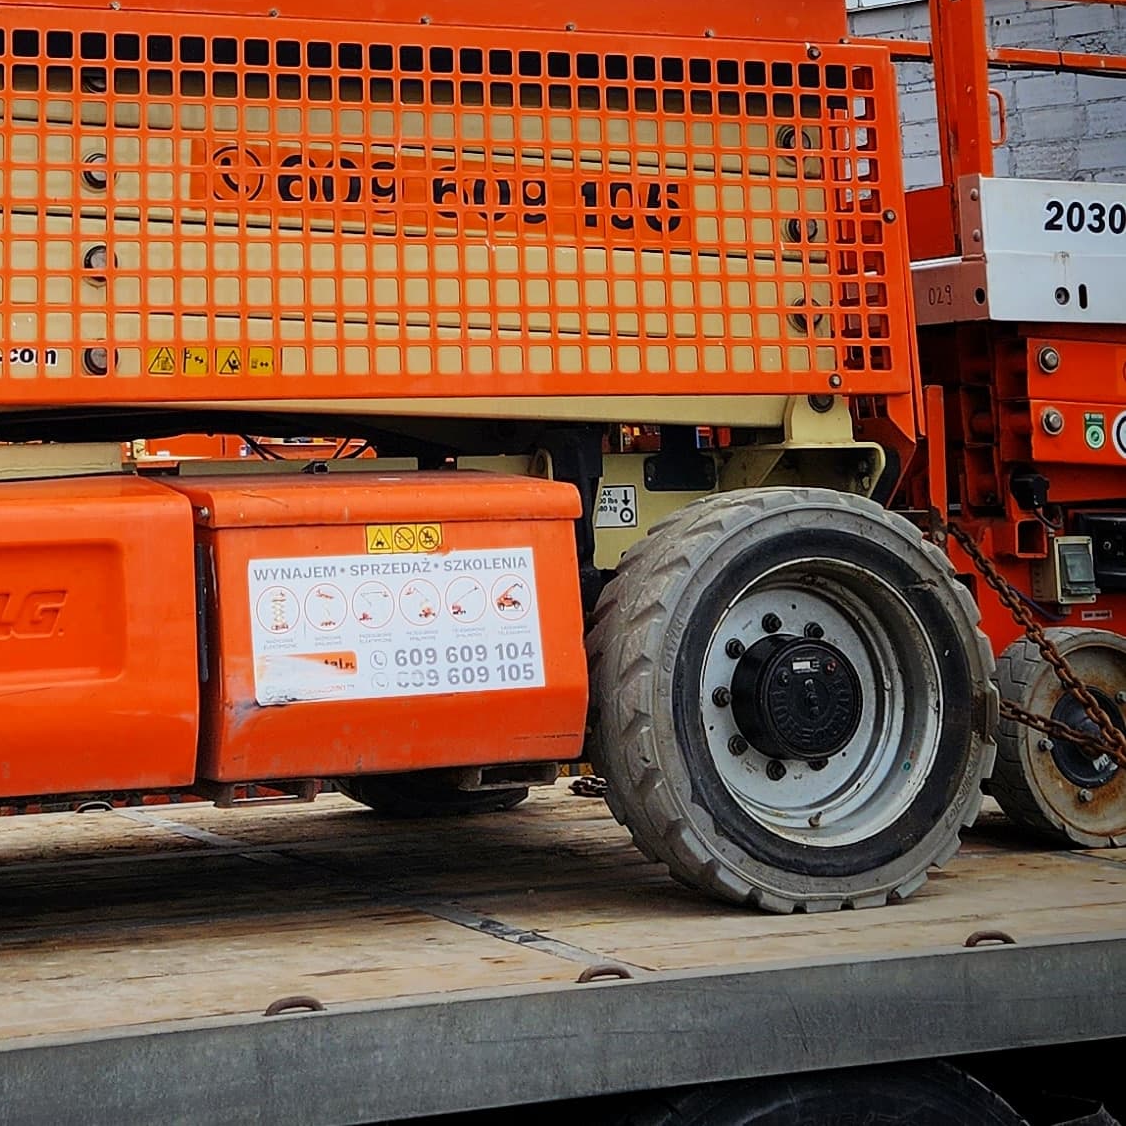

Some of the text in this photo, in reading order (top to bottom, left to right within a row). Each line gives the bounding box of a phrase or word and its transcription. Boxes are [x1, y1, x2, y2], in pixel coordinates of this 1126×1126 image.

[254, 556, 528, 581] WYNAJEM SPRZEDAŻ SZKOLENIA
[395, 641, 535, 667] 609 609 104
[447, 665, 490, 685] 609
[497, 662, 534, 682] 105
